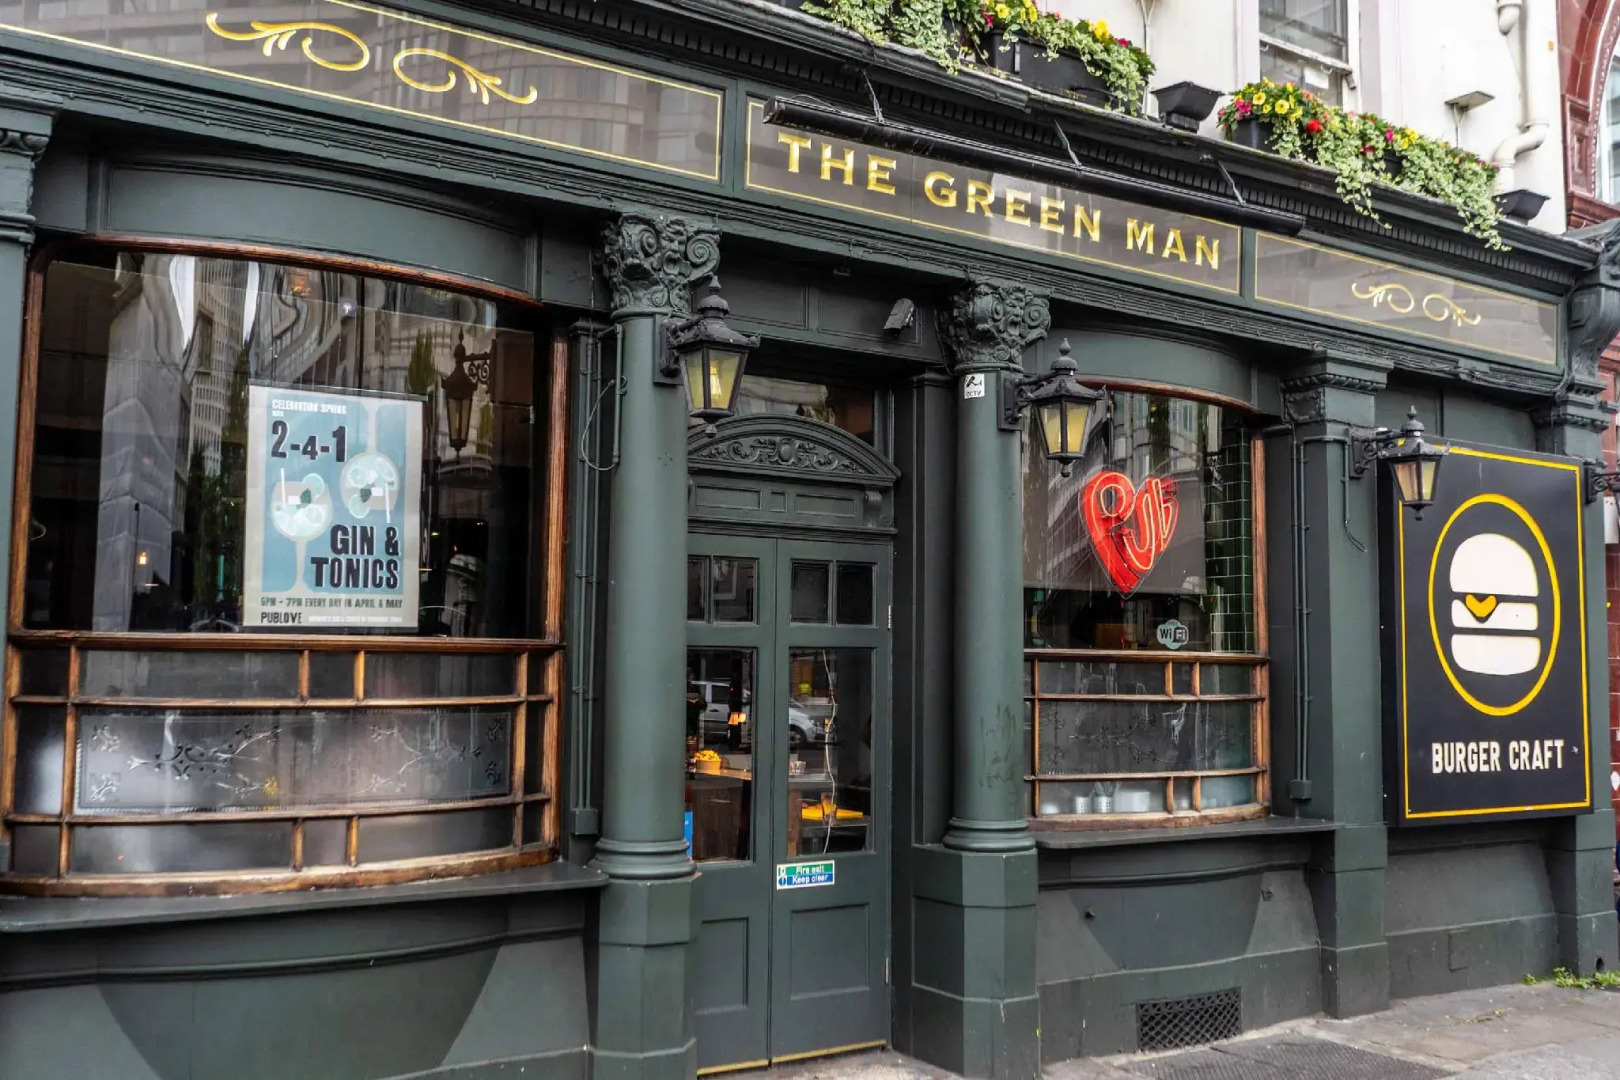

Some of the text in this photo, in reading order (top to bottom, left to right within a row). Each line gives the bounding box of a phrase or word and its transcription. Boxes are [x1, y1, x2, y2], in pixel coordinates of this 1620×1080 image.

[778, 131, 1220, 270] THE GREEN MAN
[271, 420, 347, 463] 2-4-1
[330, 524, 400, 557] GIN &
[310, 557, 400, 589] TONICS
[260, 597, 276, 607] 5PM
[286, 597, 303, 607] 7PM
[305, 597, 326, 608] EVERY
[329, 598, 342, 608] DAY
[344, 598, 352, 608] IN
[354, 598, 376, 609] APRIL
[385, 599, 403, 609] MAY
[260, 612, 302, 624] PUBLOVE
[1431, 738, 1565, 774] BURGER CRAFT
[792, 874, 829, 885] Keep clear
[796, 864, 825, 875] Fire exit
